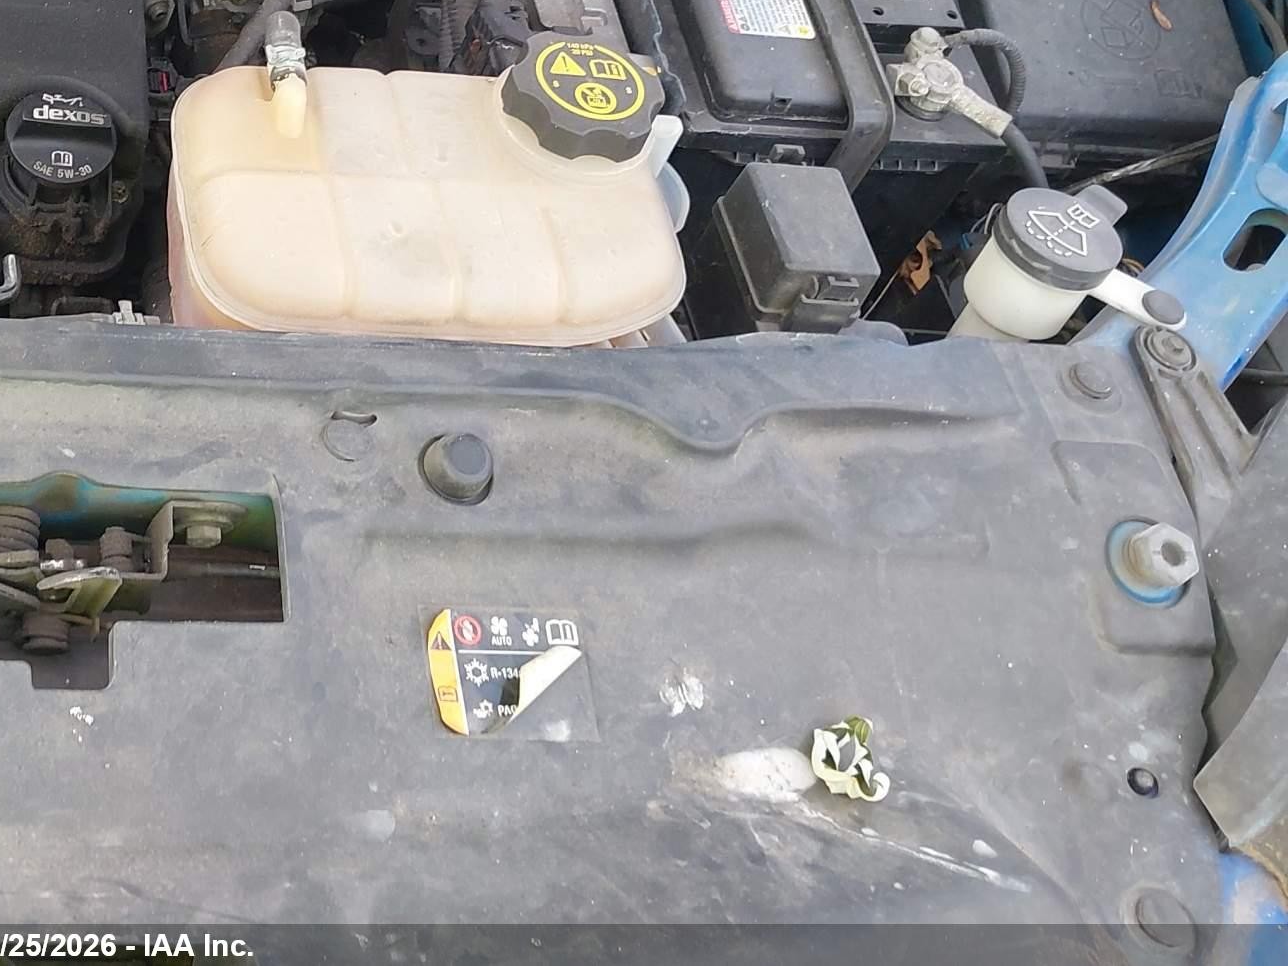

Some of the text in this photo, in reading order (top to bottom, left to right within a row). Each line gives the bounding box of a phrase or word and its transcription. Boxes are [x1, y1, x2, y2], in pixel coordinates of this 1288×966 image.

[33, 105, 107, 125] dexos
[33, 161, 93, 179] SAE 5W-30
[491, 636, 513, 646] AUTO
[490, 667, 521, 680] R-134
